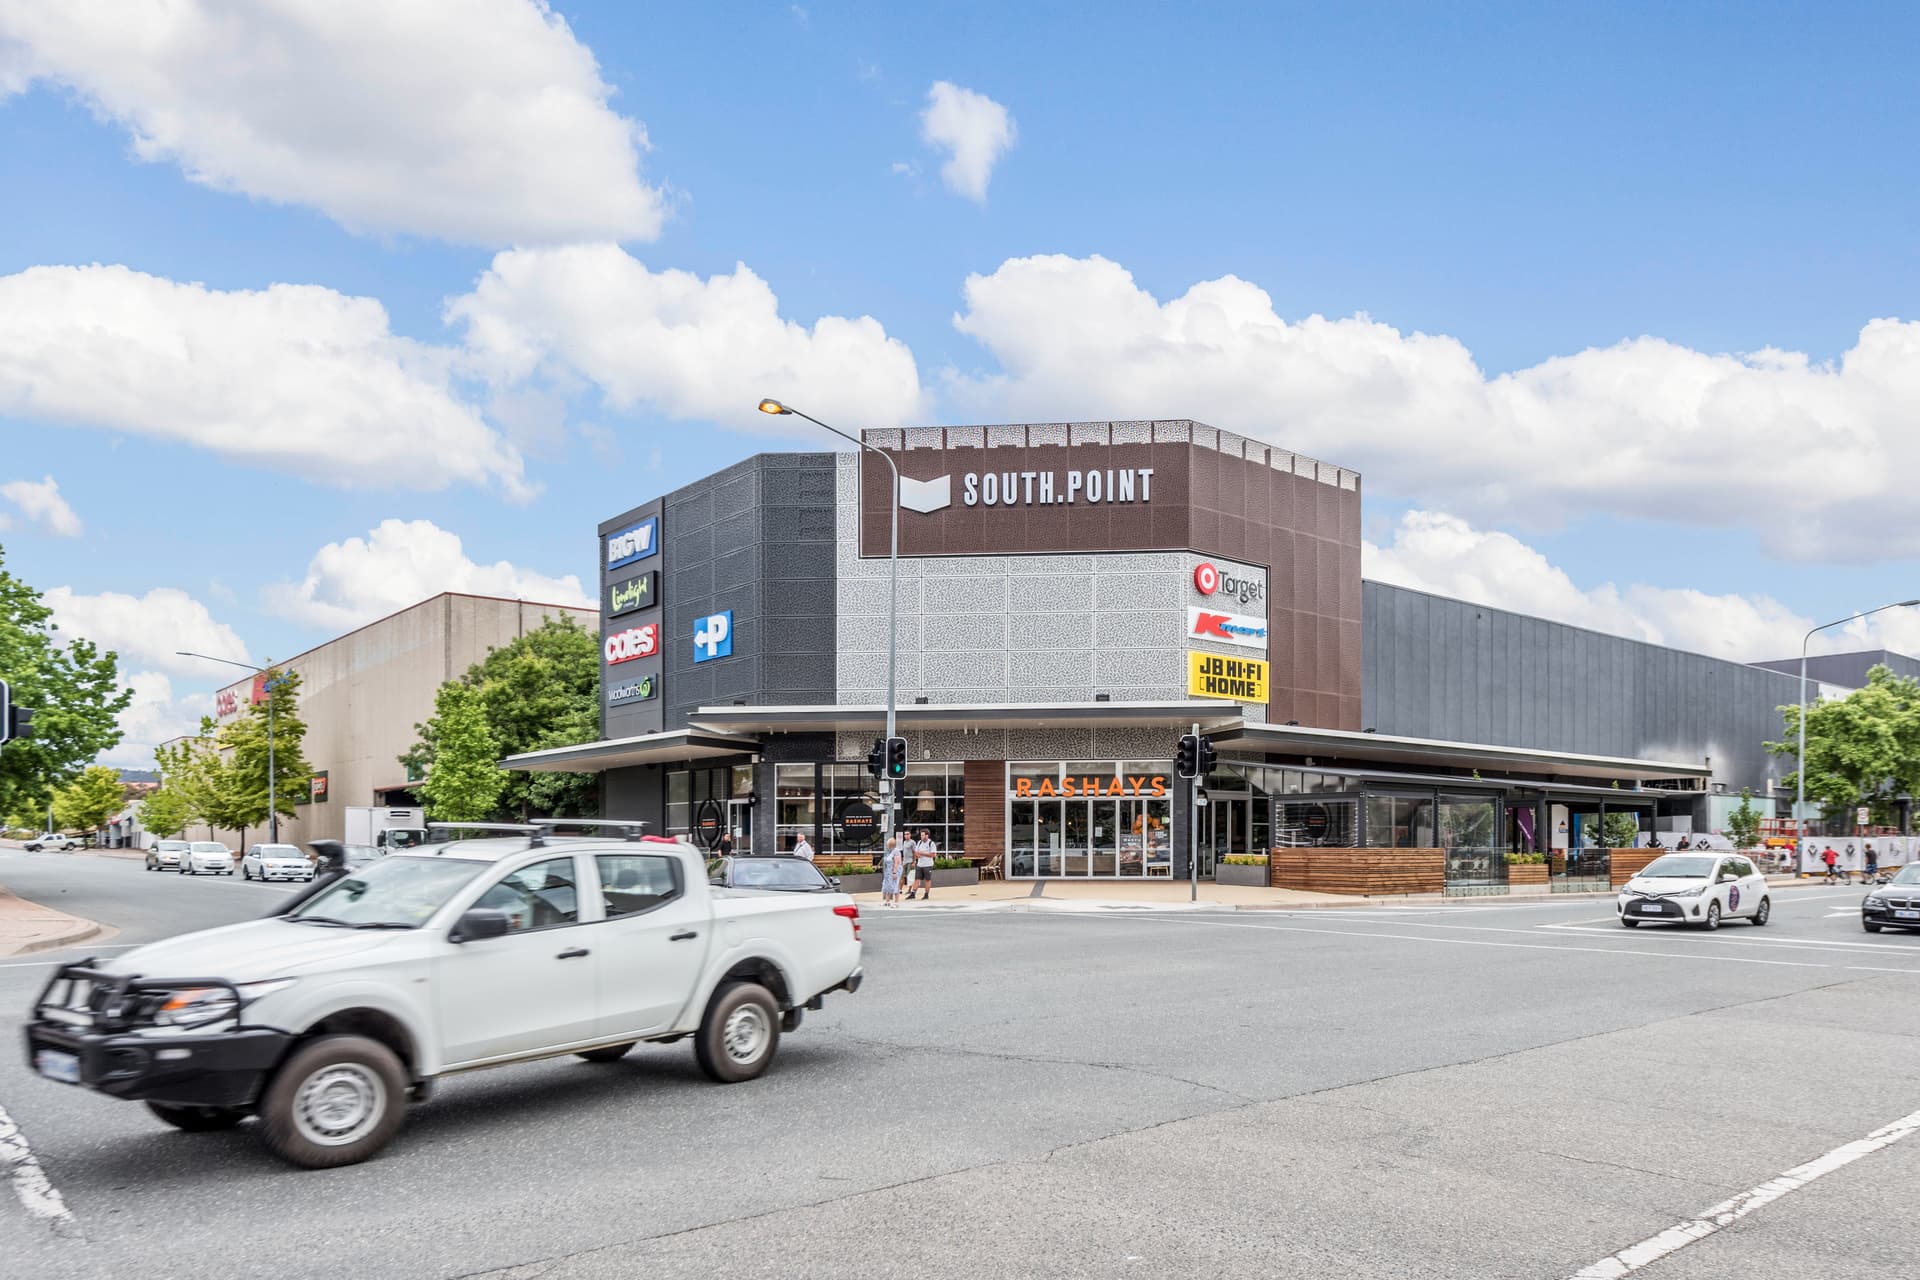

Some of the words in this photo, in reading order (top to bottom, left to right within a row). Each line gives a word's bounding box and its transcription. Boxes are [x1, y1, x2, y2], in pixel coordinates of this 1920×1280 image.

[963, 469, 1154, 505] SOUTH.POINT
[1218, 571, 1263, 603] Target
[707, 615, 728, 656] P
[1194, 612, 1267, 639] Kmart
[1200, 657, 1223, 676] JB
[1016, 777, 1166, 798] RASHAYS
